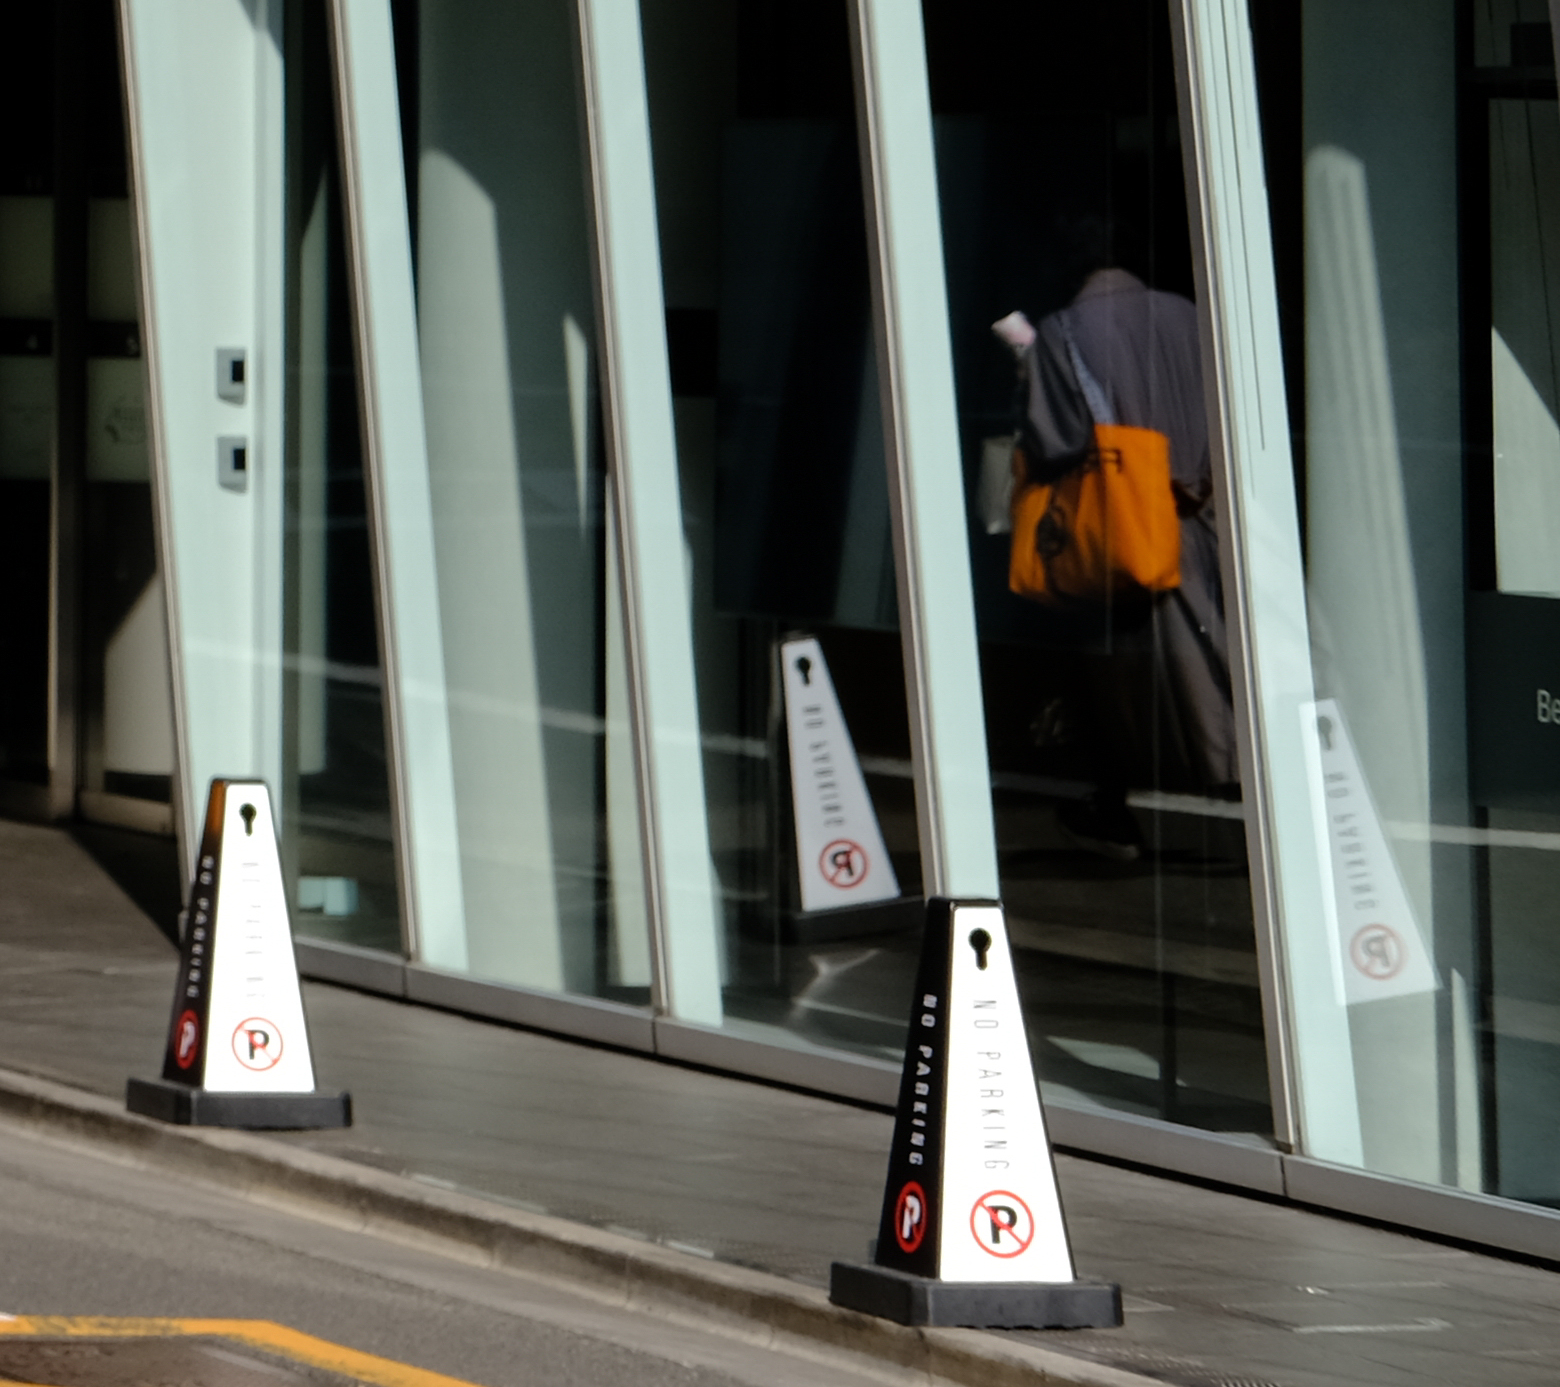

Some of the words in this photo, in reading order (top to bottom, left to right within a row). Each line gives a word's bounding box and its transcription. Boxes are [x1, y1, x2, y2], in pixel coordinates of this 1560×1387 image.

[920, 993, 938, 1028] NO
[972, 999, 1000, 1029] NO
[908, 1044, 934, 1167] PARKING
[977, 1050, 1010, 1170] PARKING
